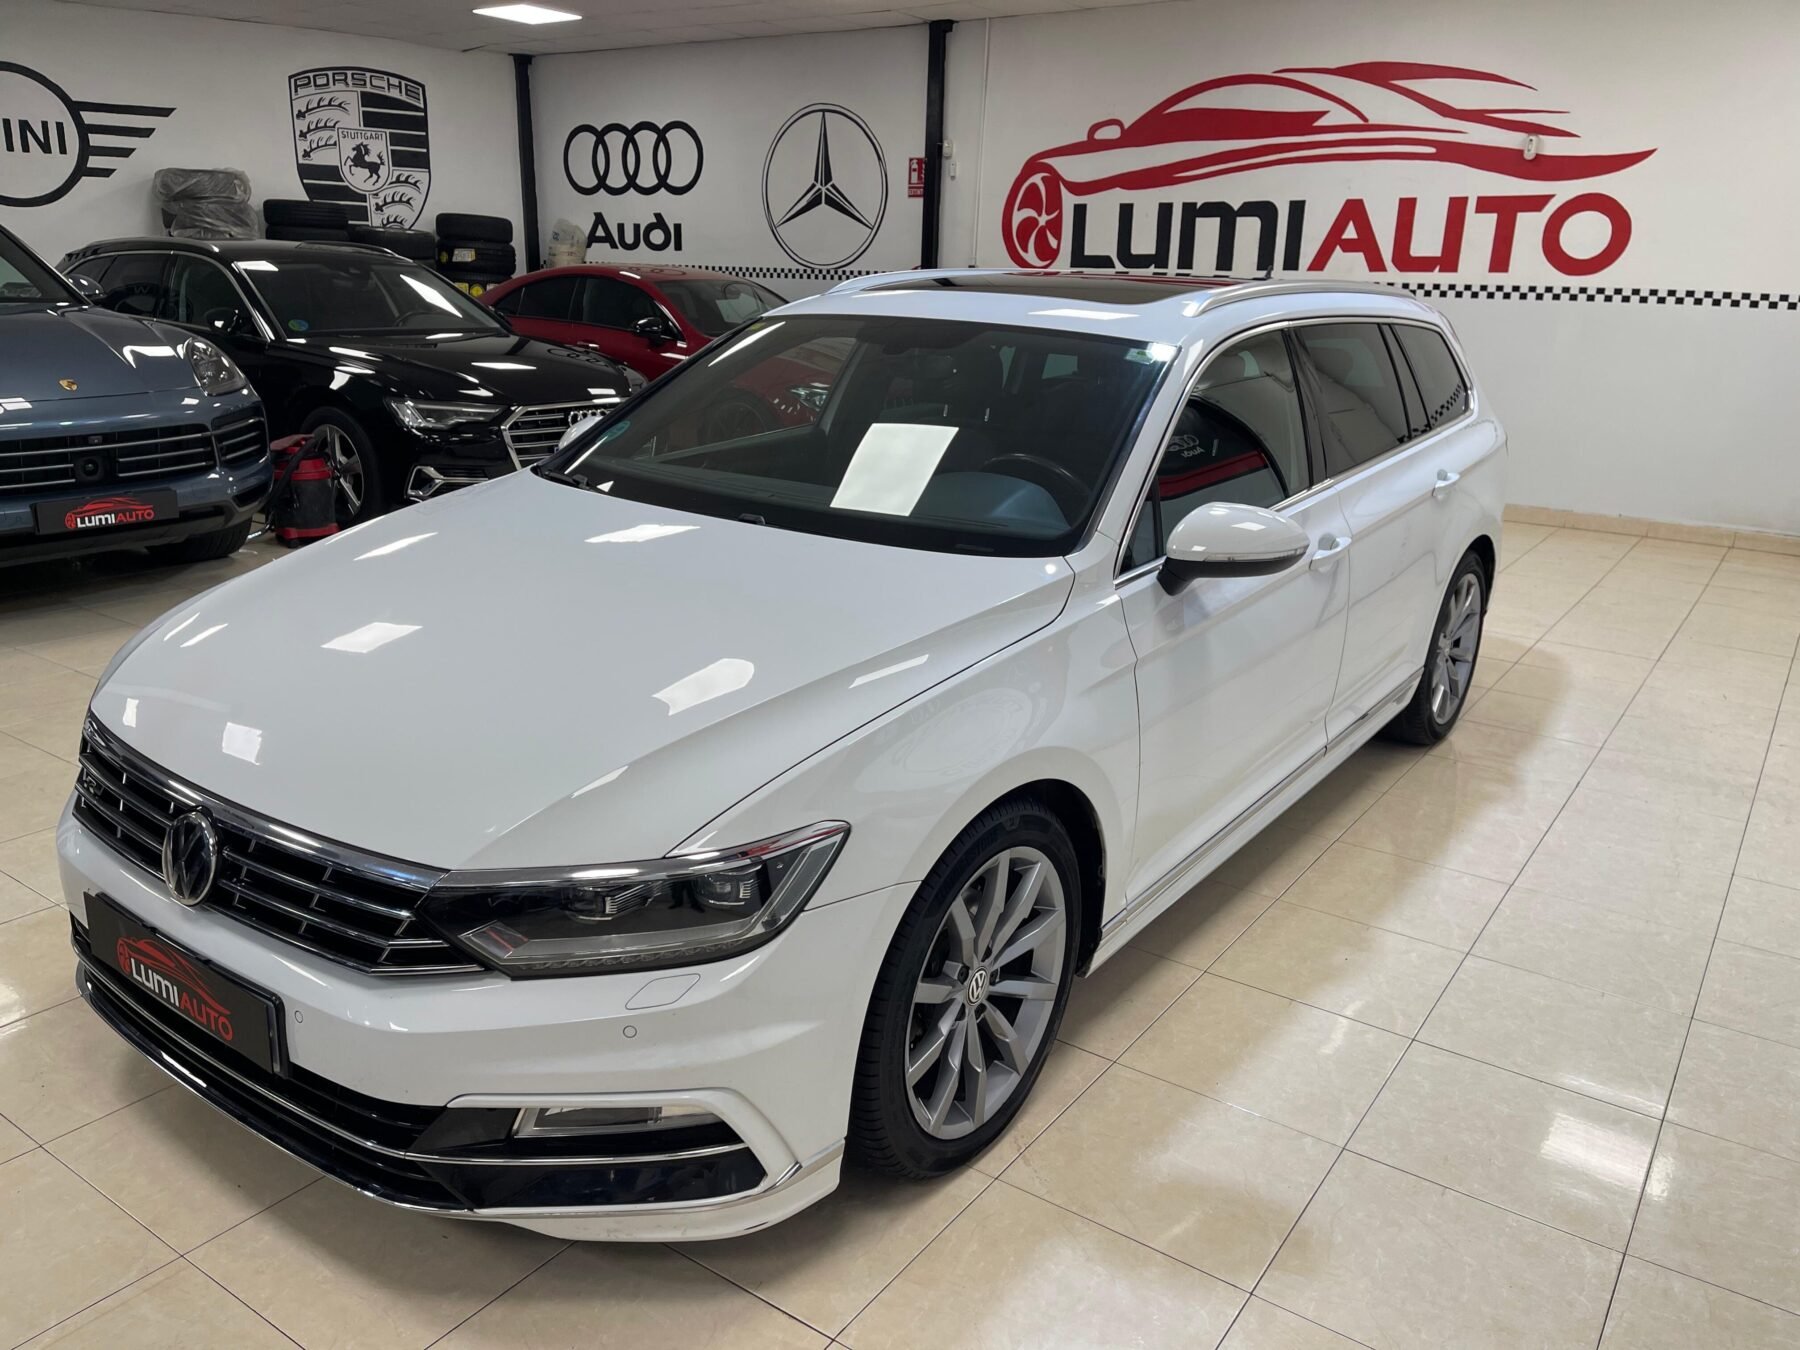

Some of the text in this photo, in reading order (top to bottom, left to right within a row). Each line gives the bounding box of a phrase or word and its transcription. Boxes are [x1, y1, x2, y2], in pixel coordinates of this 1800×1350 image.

[294, 71, 422, 104] PORSCHE
[341, 130, 384, 141] STUTTGART
[586, 212, 683, 251] Audi
